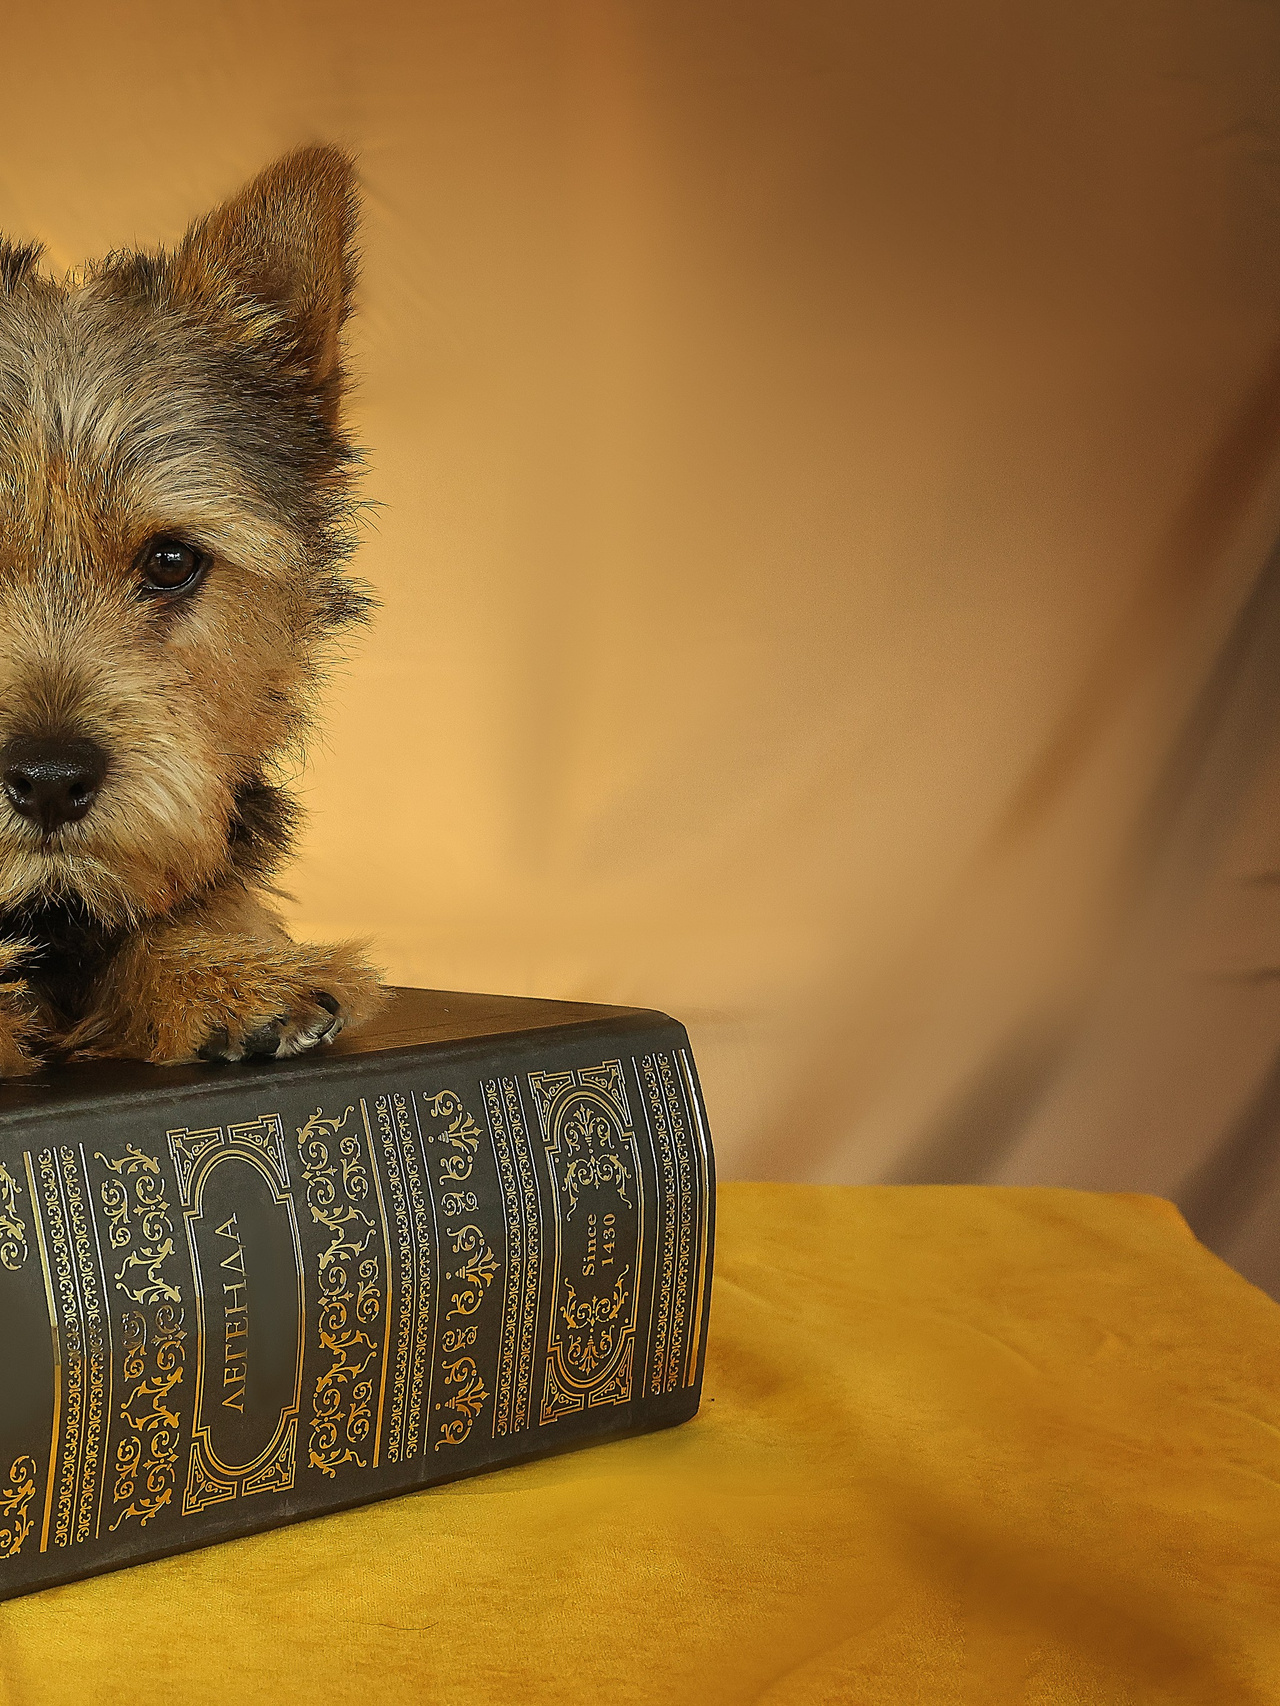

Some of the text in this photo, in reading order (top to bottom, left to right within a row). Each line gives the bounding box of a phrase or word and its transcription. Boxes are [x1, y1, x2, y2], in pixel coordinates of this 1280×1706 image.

[581, 1213, 597, 1277] Since
[601, 1212, 617, 1267] 1430
[214, 1212, 249, 1414] ЛЕГЕНДА
